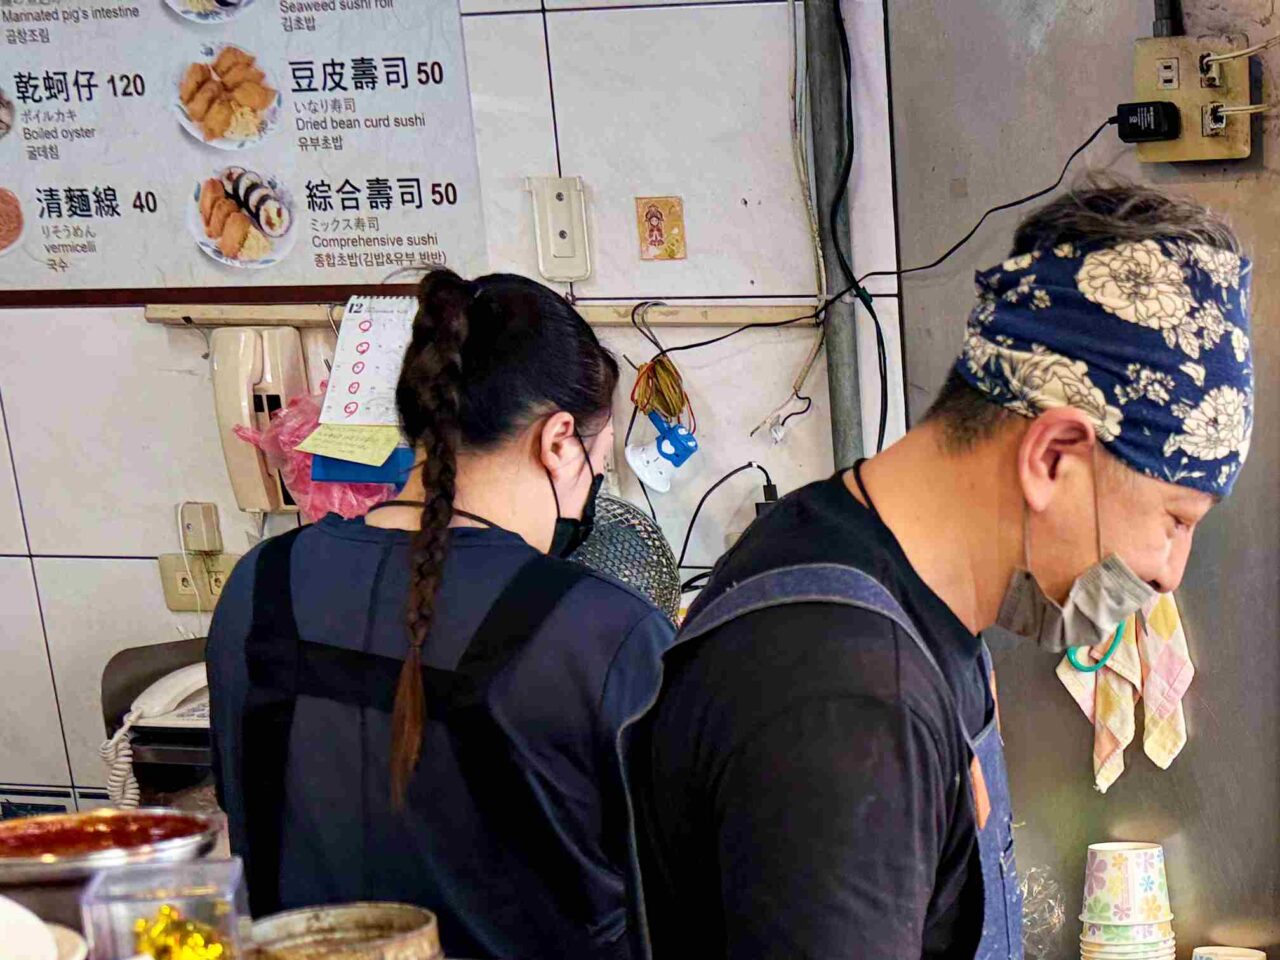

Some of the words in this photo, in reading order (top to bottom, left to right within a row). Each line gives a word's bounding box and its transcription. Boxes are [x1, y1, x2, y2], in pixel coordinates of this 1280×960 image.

[2, 8, 59, 23] Marinated
[62, 7, 89, 23] pig's
[92, 5, 140, 20] intestine
[280, 0, 336, 13] Seaweed
[340, 0, 371, 10] sushi
[281, 15, 316, 32] 김초밥
[289, 57, 408, 93] 豆皮壽司
[417, 61, 443, 85] 50
[14, 70, 98, 103] 乾蚵仔
[107, 74, 145, 97] 120
[294, 98, 356, 114] いなり寿司
[21, 109, 77, 123] ボイルカキ
[296, 117, 328, 131] Dried
[331, 115, 361, 130] bean
[364, 114, 390, 128] curd
[394, 113, 425, 127] sushi
[23, 127, 59, 140] Boiled
[62, 127, 96, 141] oyster
[298, 135, 343, 151] 유부초밥
[36, 185, 121, 218] 清麵線
[133, 191, 157, 213] 40
[305, 177, 423, 212] 綜合壽司
[431, 182, 457, 205] 50
[311, 216, 379, 232] ミックス寿司
[44, 240, 97, 253] vermicelli
[312, 235, 403, 250] Comprehensive
[407, 233, 438, 246] sushi
[348, 303, 363, 314] 12
